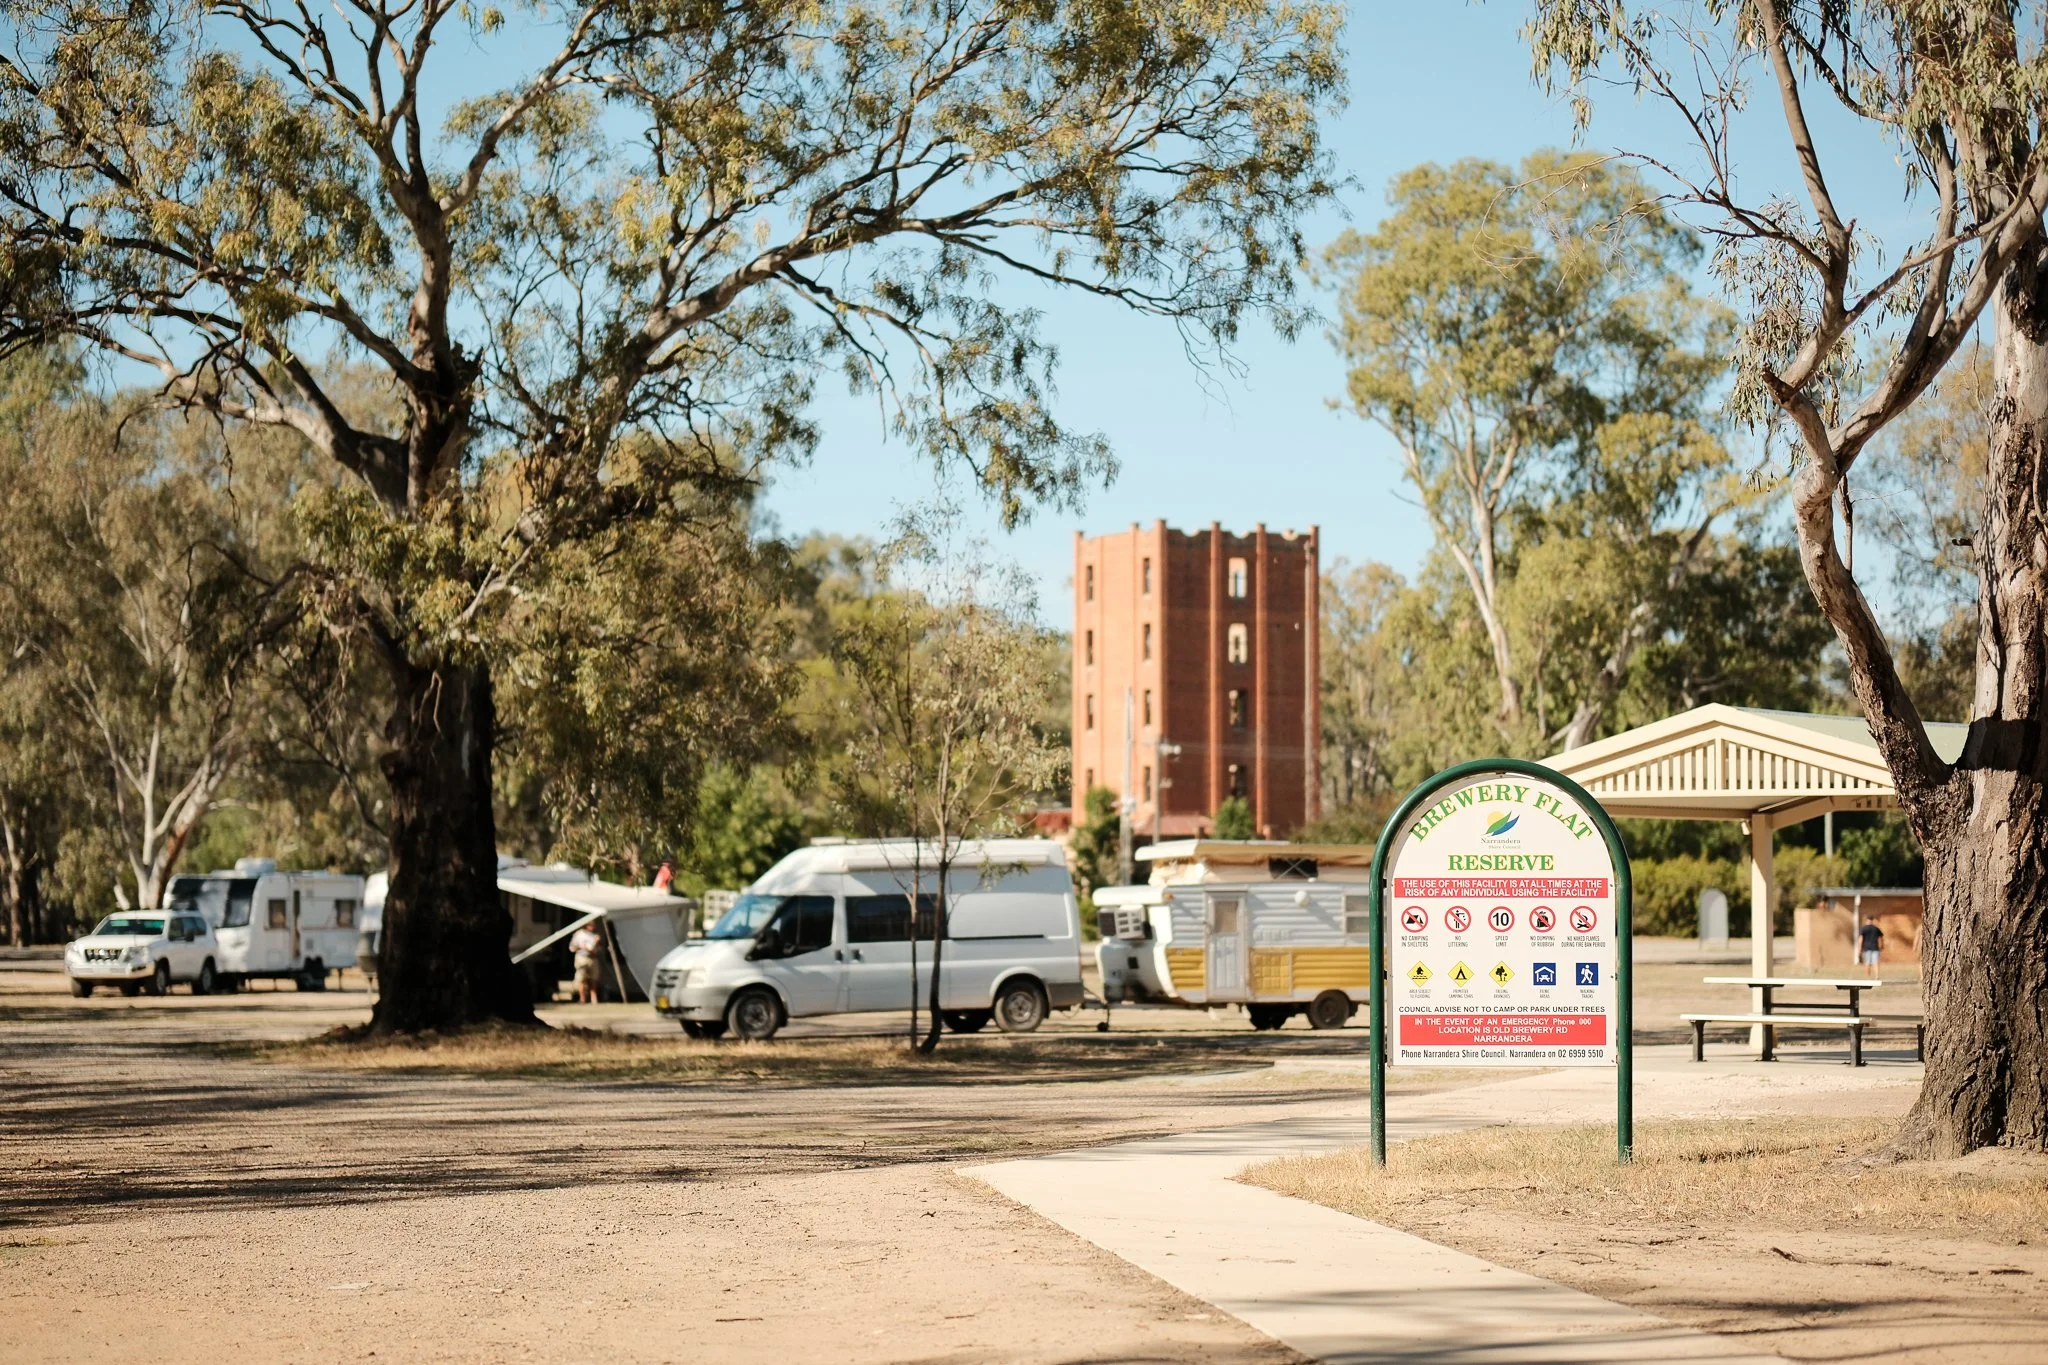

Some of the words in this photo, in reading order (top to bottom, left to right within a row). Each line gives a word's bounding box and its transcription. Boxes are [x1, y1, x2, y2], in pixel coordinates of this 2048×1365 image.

[1410, 784, 1530, 841] BREWERY
[1533, 791, 1593, 840] FLAT
[1448, 854, 1554, 870] RESERVE
[1493, 912, 1509, 926] 10
[1402, 1050, 1421, 1058] Phone
[1424, 1050, 1459, 1058] Narrandera
[1462, 1050, 1478, 1058] Shire
[1510, 1050, 1546, 1058] Narrandera
[1548, 1050, 1555, 1058] on
[1558, 1050, 1566, 1058] 02
[1569, 1050, 1585, 1058] 6959
[1588, 1050, 1604, 1058] 5510
